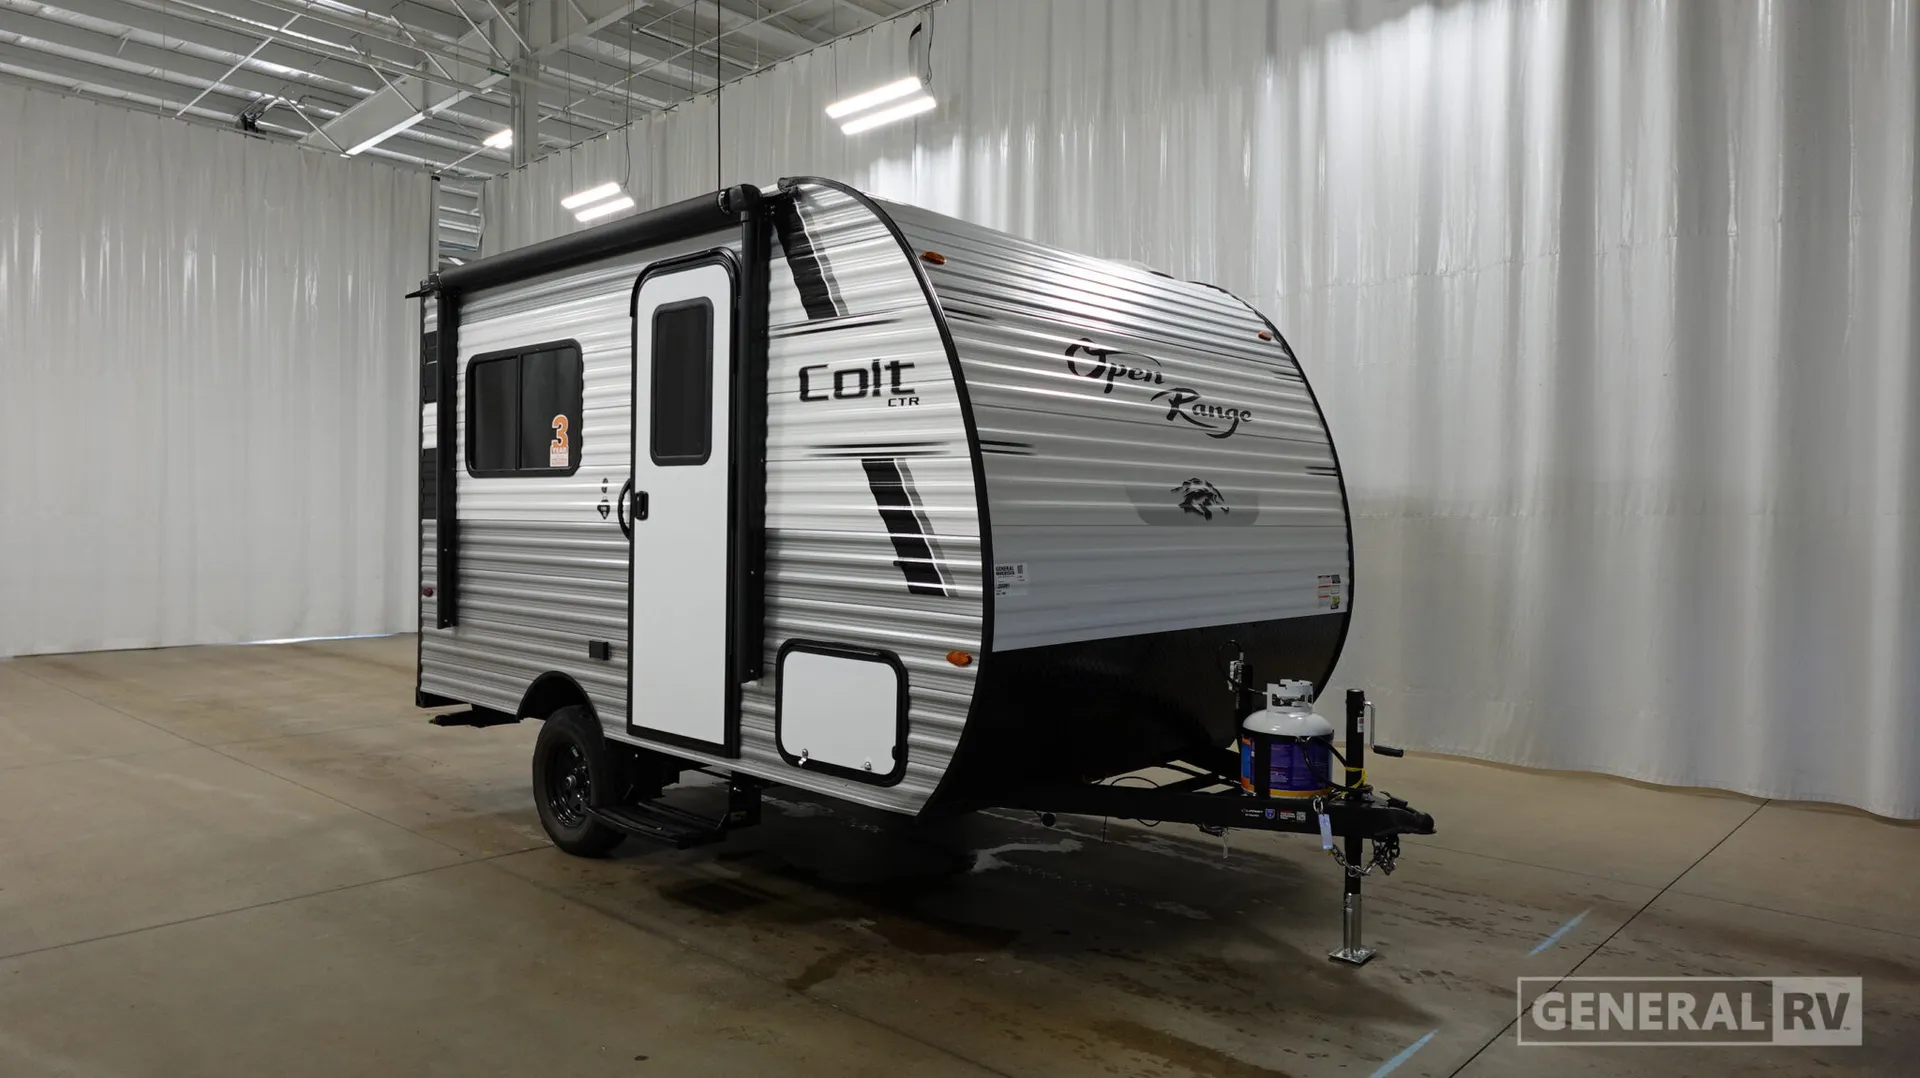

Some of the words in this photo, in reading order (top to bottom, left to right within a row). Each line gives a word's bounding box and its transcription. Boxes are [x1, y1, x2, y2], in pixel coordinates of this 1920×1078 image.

[798, 358, 915, 402] Colt
[1064, 337, 1165, 394] Open
[887, 397, 920, 407] CTR
[1150, 387, 1253, 439] Range
[551, 414, 569, 447] 3
